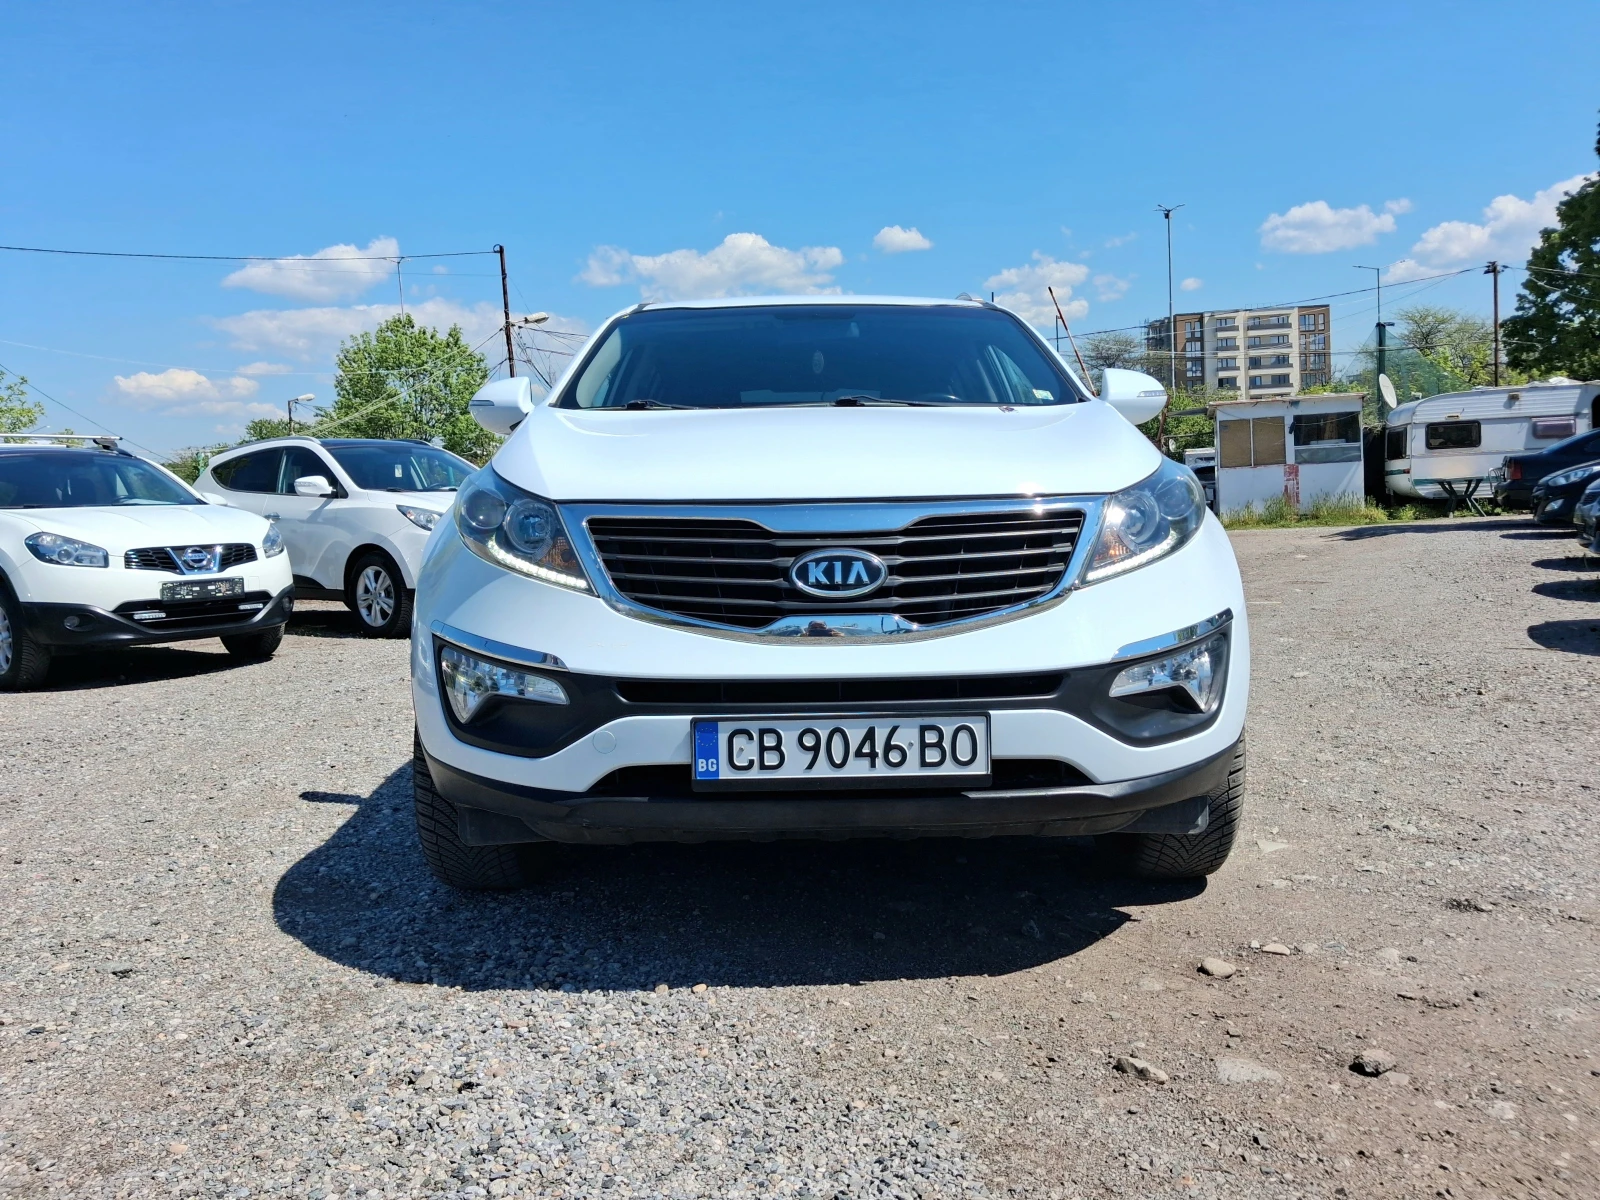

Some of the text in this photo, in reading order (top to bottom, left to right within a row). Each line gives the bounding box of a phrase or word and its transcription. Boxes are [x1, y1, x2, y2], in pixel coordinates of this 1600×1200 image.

[807, 561, 870, 584] KIA
[727, 723, 978, 771] CB 9046 BO
[698, 758, 717, 772] BG
